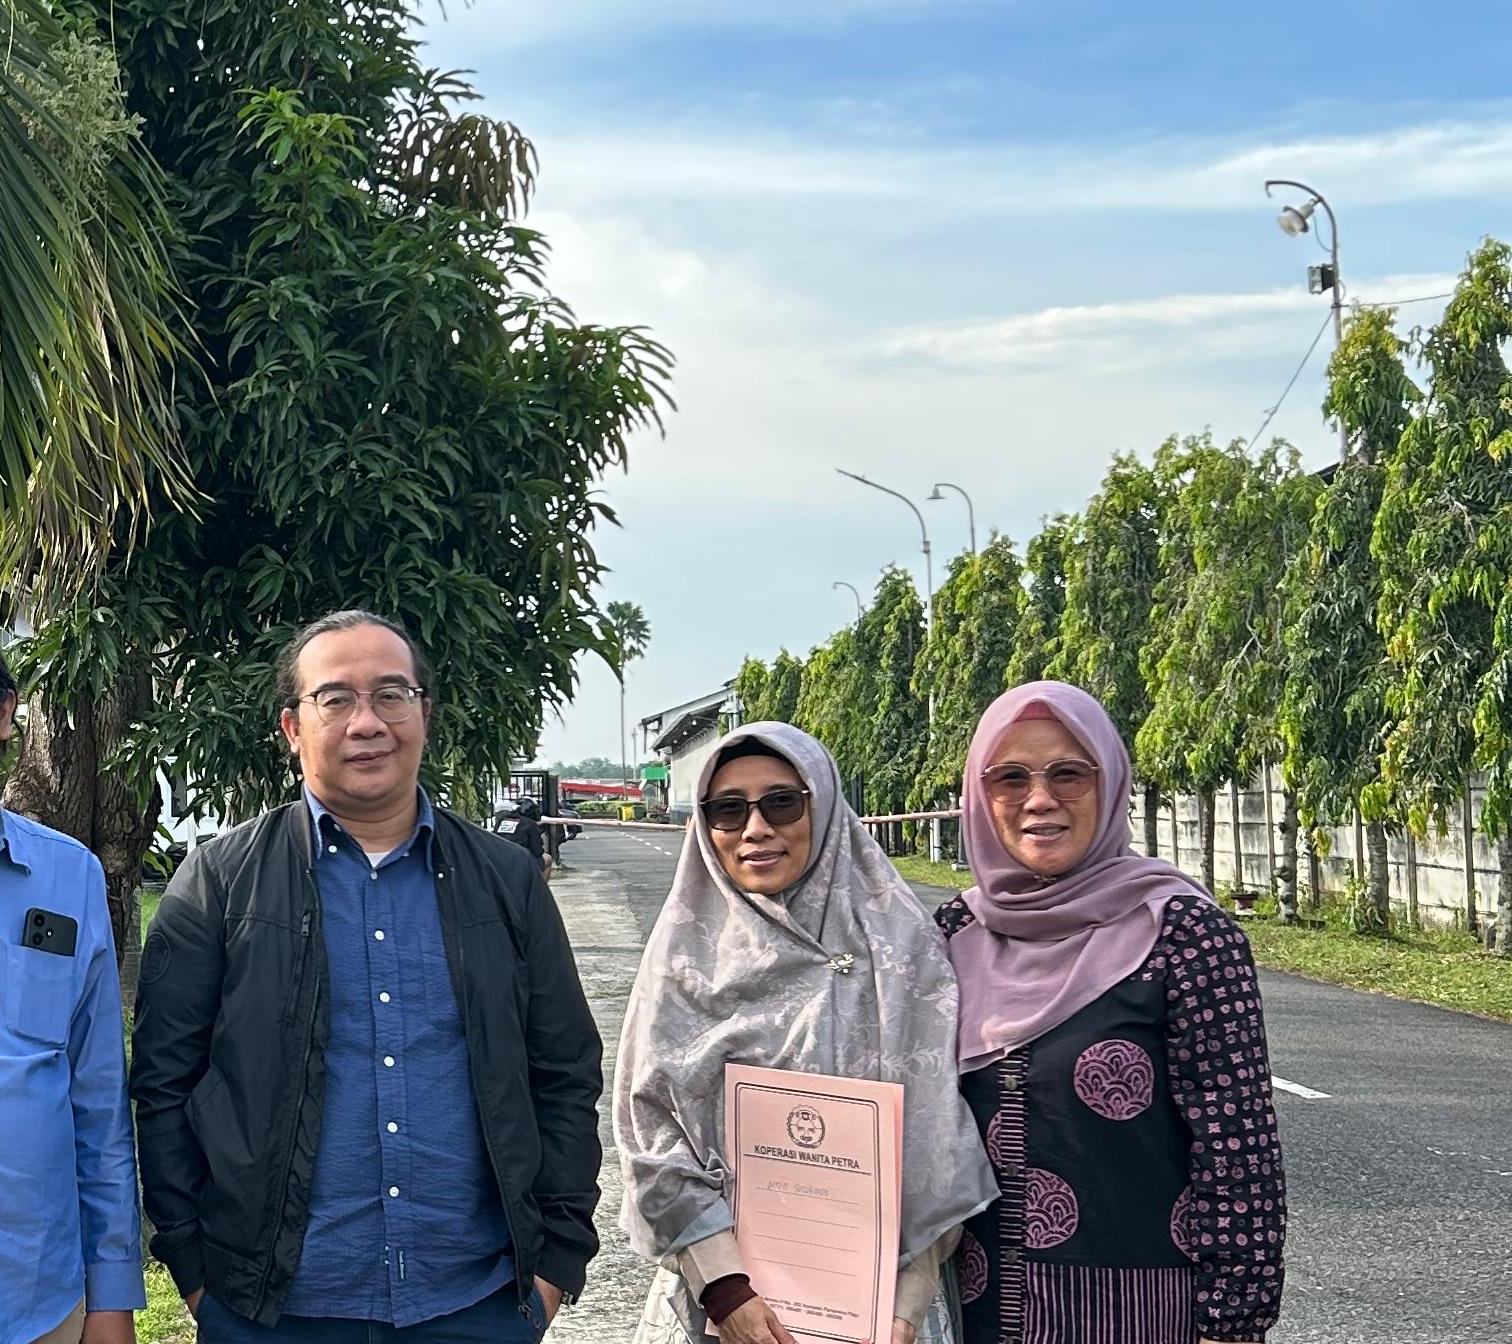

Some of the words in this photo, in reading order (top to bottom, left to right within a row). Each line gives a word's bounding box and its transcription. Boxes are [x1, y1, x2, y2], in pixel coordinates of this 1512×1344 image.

[754, 1144, 797, 1159] KOPERASI
[798, 1151, 831, 1165] WANITA
[831, 1156, 861, 1170] PETRA
